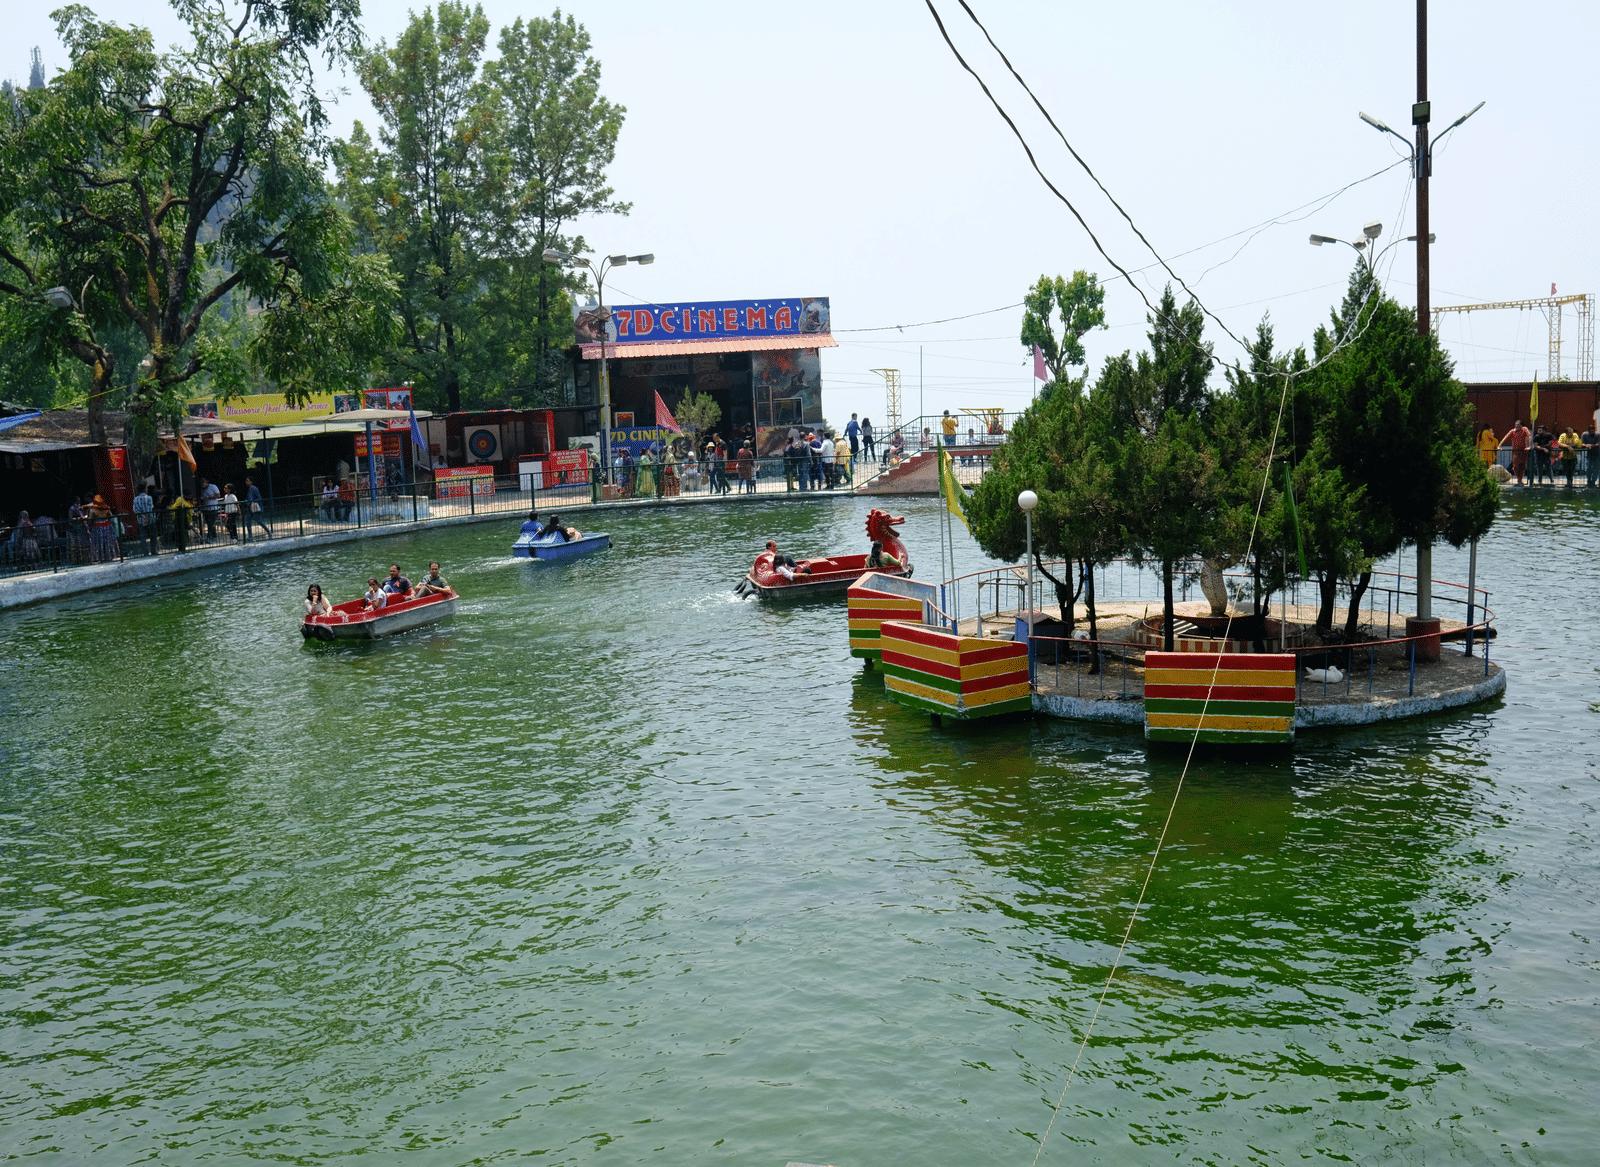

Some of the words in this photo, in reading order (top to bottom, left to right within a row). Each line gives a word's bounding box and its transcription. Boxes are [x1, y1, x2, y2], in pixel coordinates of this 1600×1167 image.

[617, 309, 654, 336] 7D
[660, 306, 792, 334] CINEMA
[223, 405, 261, 417] Mussoorie
[305, 401, 330, 412] Service
[611, 430, 626, 442] 7D
[629, 429, 671, 442] CINEM
